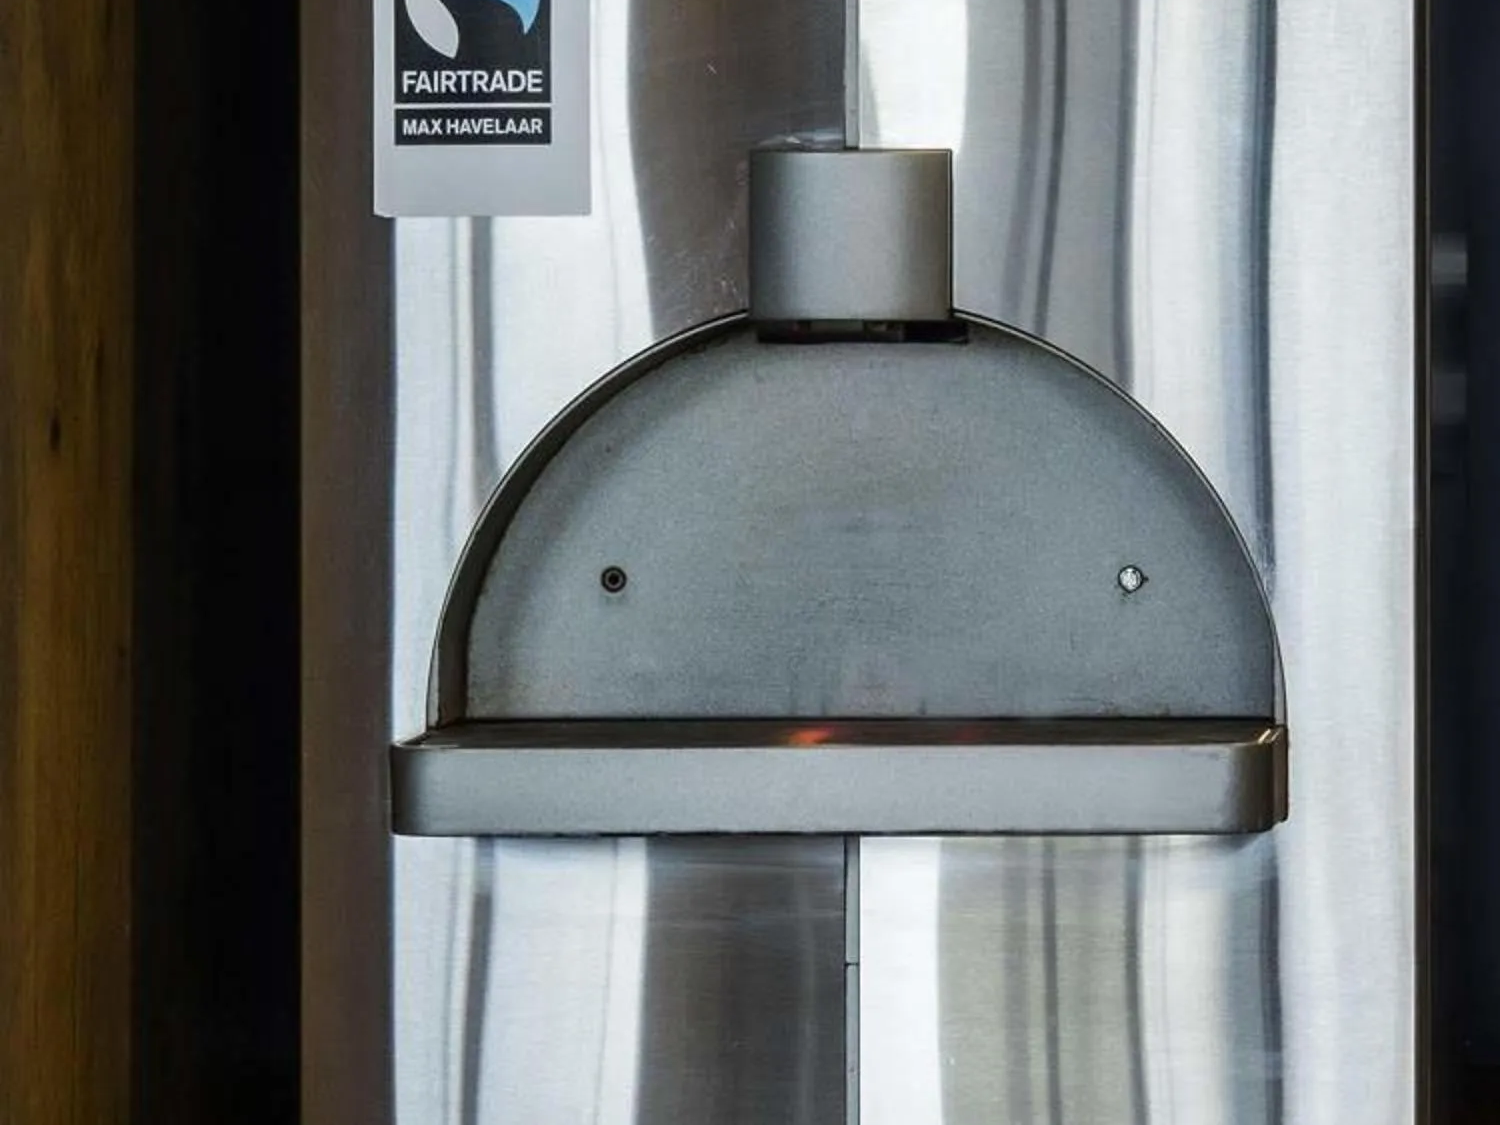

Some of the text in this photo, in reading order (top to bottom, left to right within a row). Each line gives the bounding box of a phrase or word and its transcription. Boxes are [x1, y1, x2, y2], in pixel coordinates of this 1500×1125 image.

[402, 70, 543, 94] FAIRTRADE
[402, 118, 543, 137] MAX HAVELAAR
